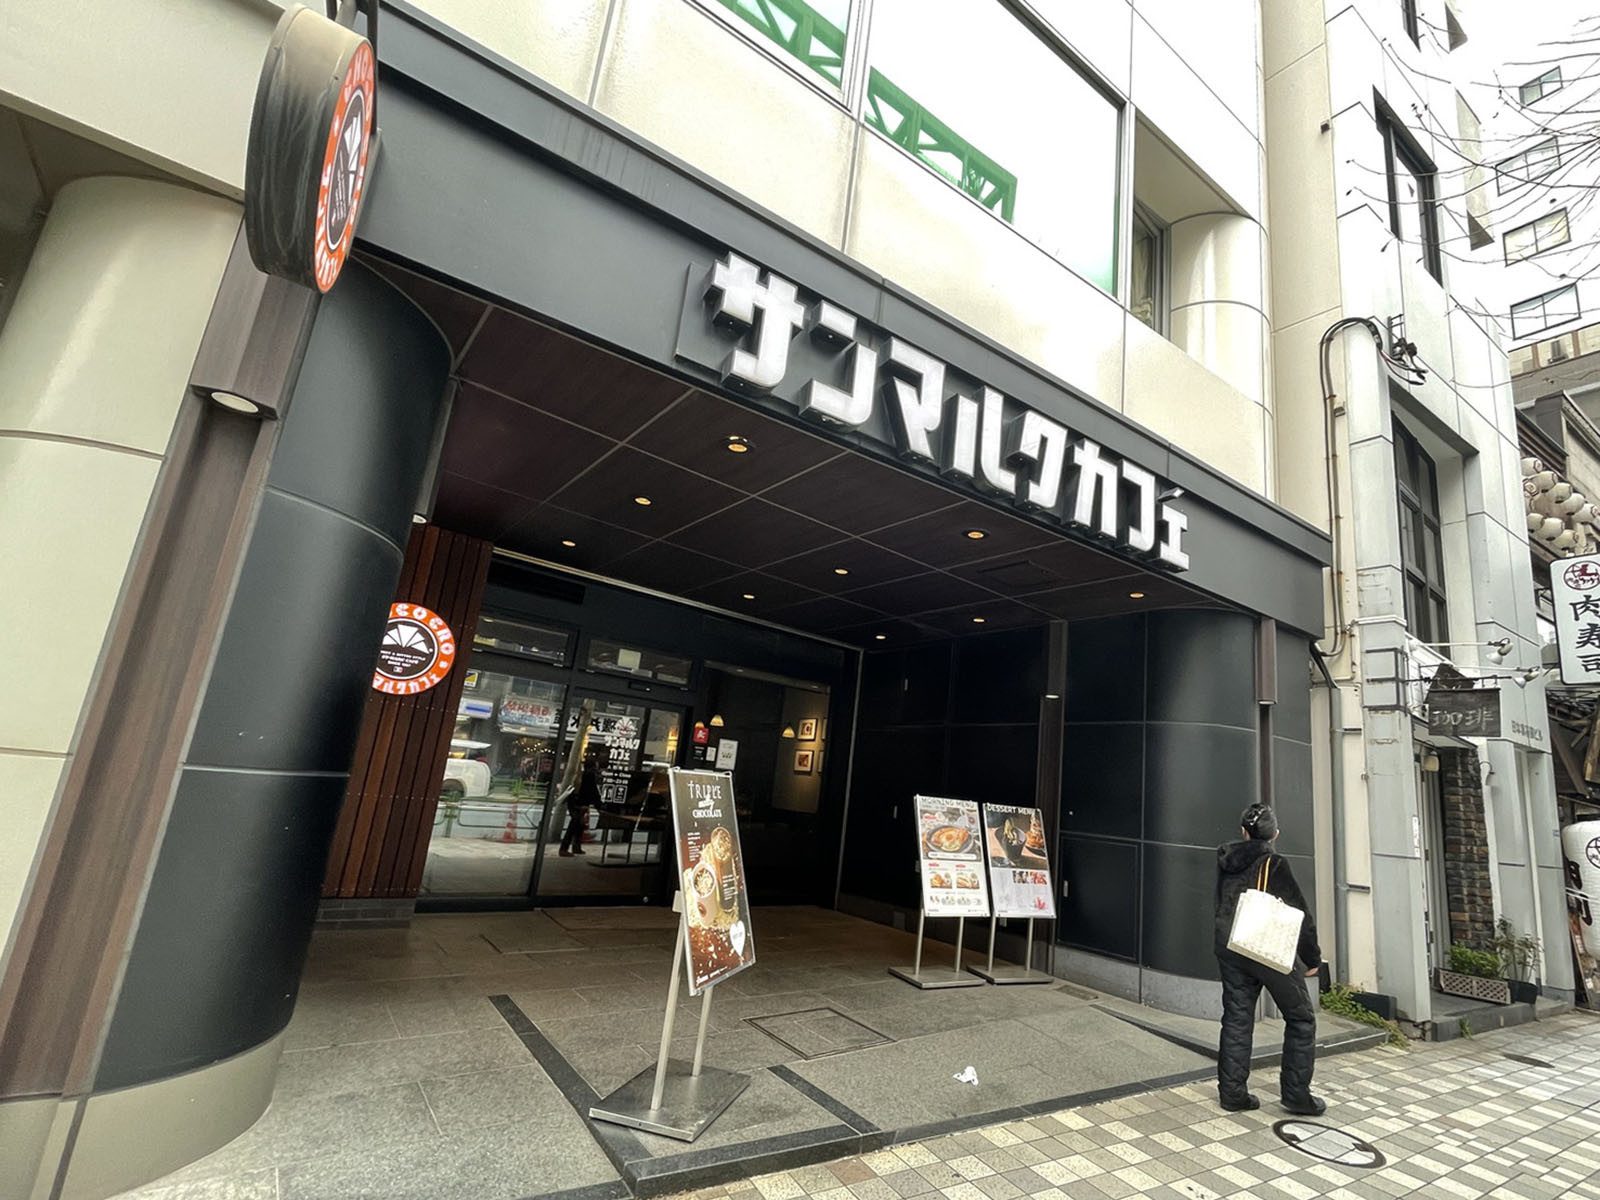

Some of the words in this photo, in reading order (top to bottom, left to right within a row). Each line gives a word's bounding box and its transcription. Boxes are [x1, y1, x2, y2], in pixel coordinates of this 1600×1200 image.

[711, 251, 1190, 572] サンマルクカフェ
[1432, 706, 1495, 731] 珈琲
[604, 735, 640, 750] サンマルク
[609, 748, 631, 760] カフェ
[688, 780, 722, 799] TRIPLE
[987, 804, 1016, 814] DESSERT
